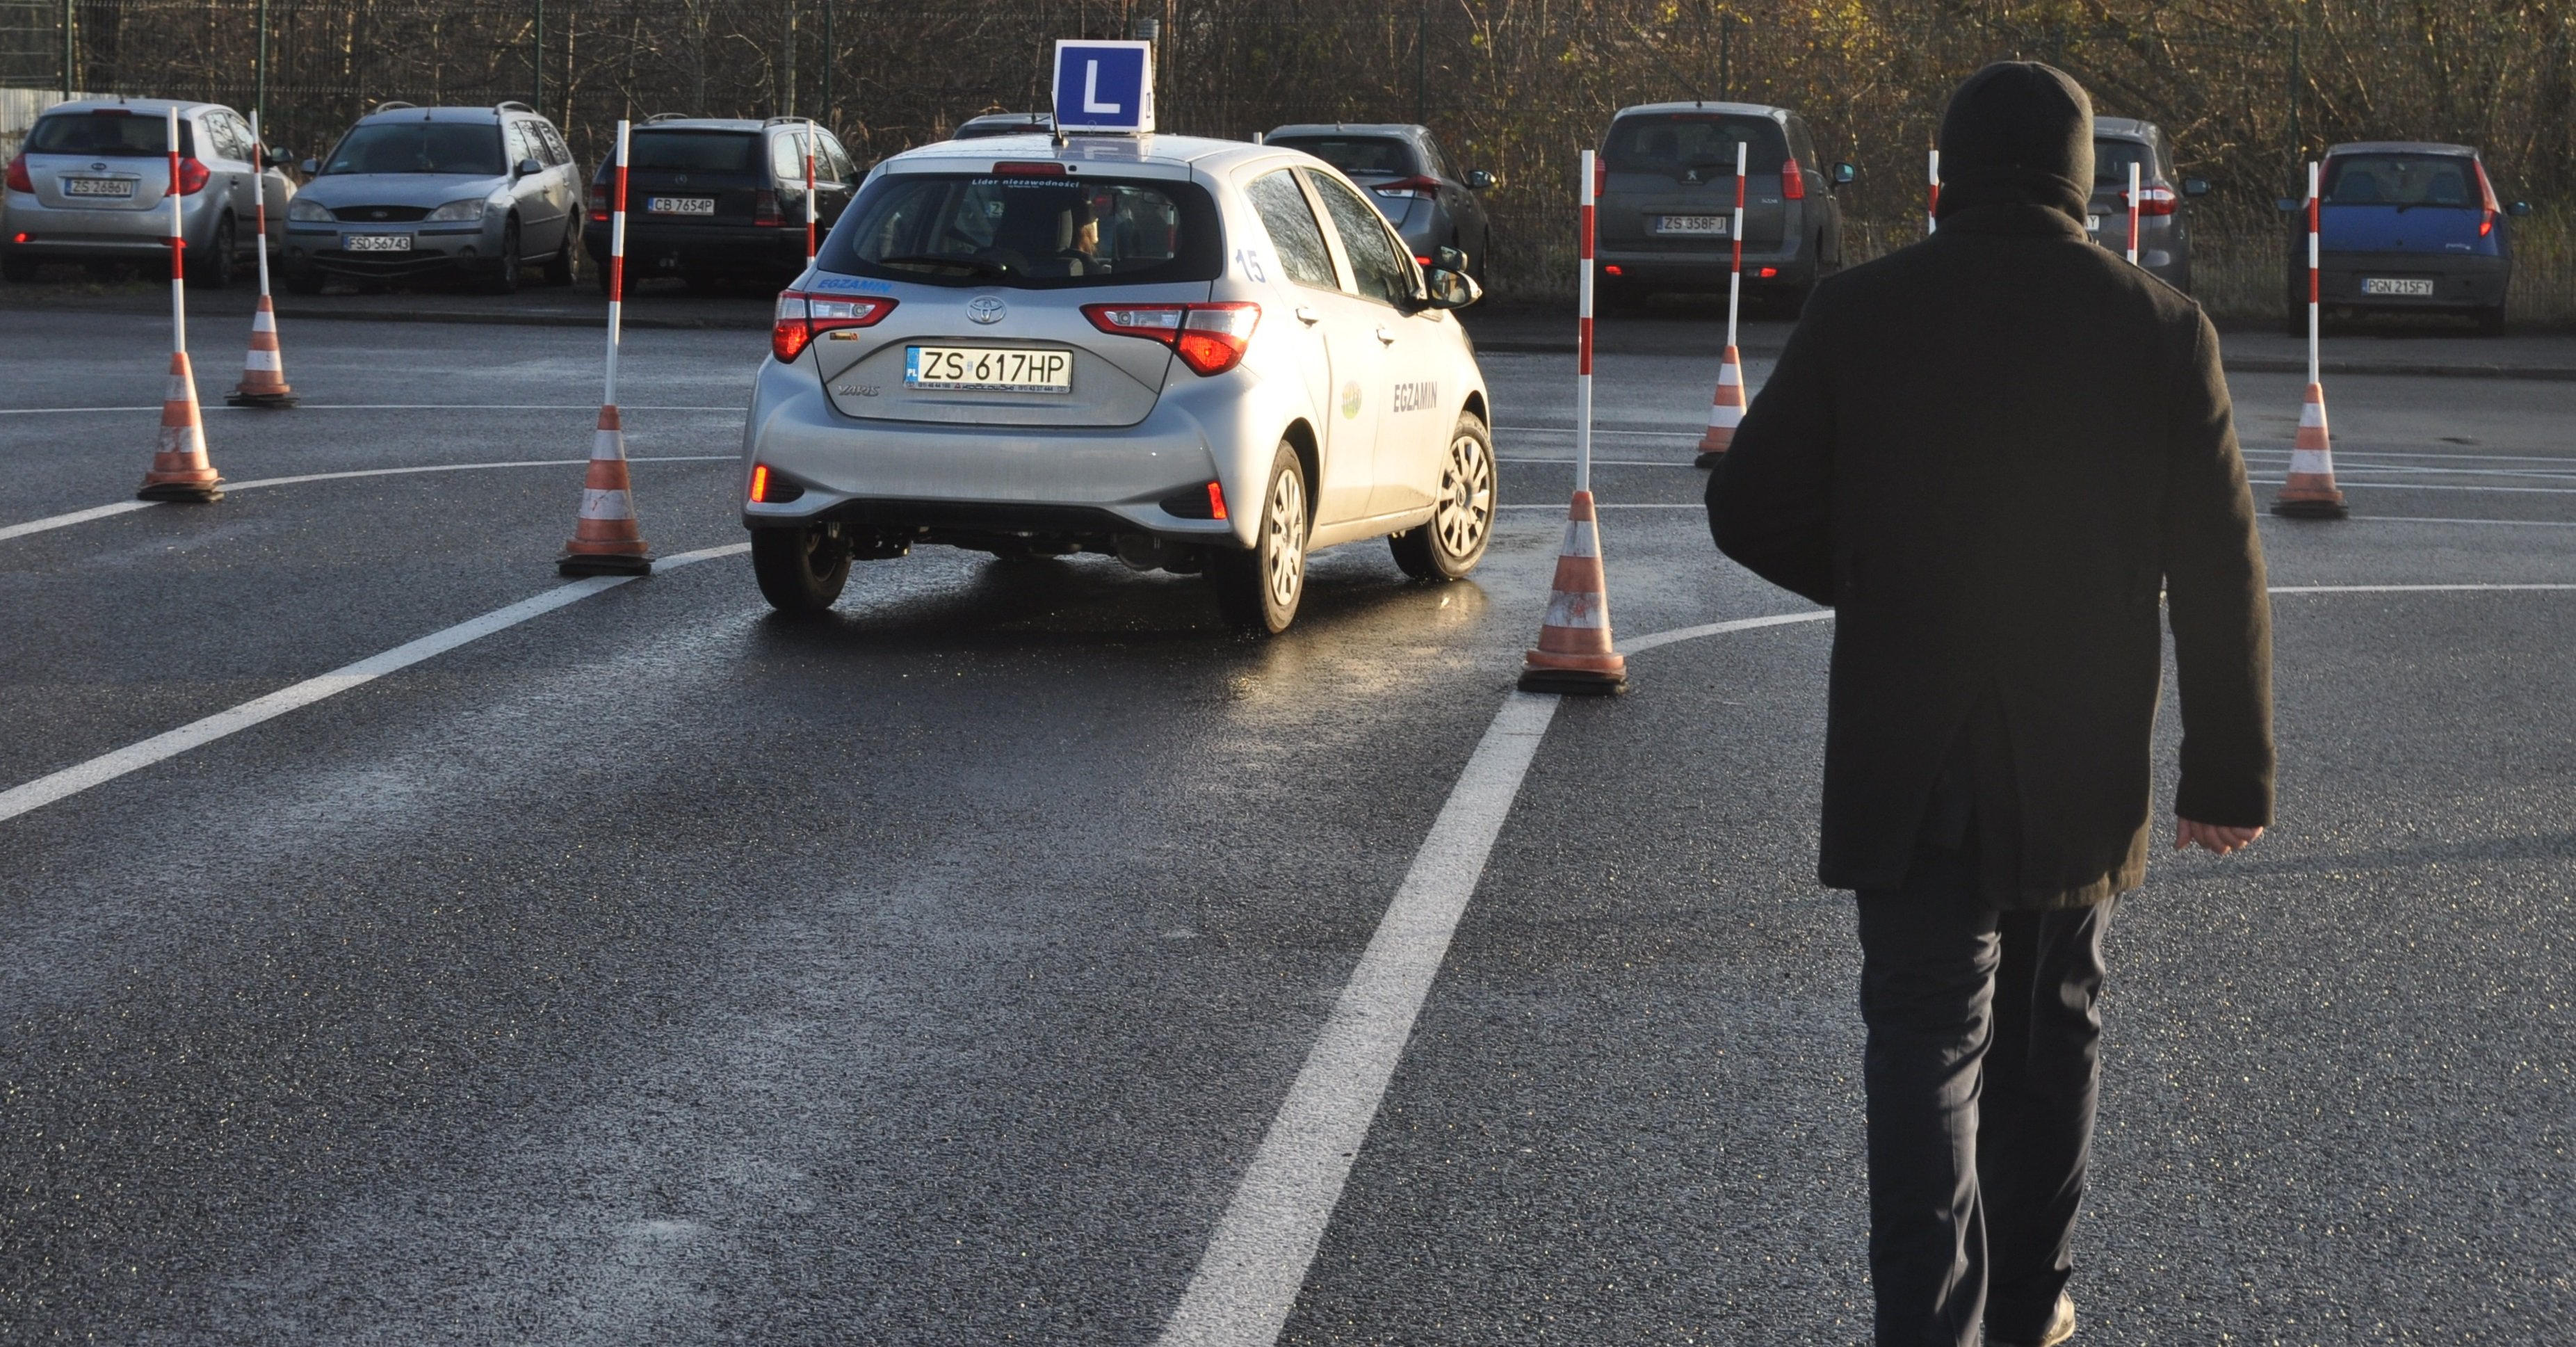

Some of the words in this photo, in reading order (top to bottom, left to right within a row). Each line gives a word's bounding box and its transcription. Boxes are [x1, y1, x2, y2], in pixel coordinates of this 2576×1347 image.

[1083, 59, 1121, 114] L
[72, 181, 90, 193] ZS
[1003, 179, 1080, 188] niezawodności
[655, 199, 672, 211] CB
[676, 199, 713, 212] 7654P
[1664, 217, 1683, 230] ZS
[1686, 218, 1724, 230] 358FJ
[349, 238, 371, 250] FSD
[373, 238, 410, 250] 56743
[1235, 248, 1266, 284] 15
[818, 279, 893, 293] EGZAMIN
[2369, 280, 2392, 293] PGN
[2395, 280, 2431, 293] 215FY
[907, 368, 918, 378] PL
[923, 351, 964, 380] ZS
[975, 353, 1064, 383] 617HP
[838, 385, 881, 397] YARIS
[1393, 381, 1437, 412] EGZAMIN
